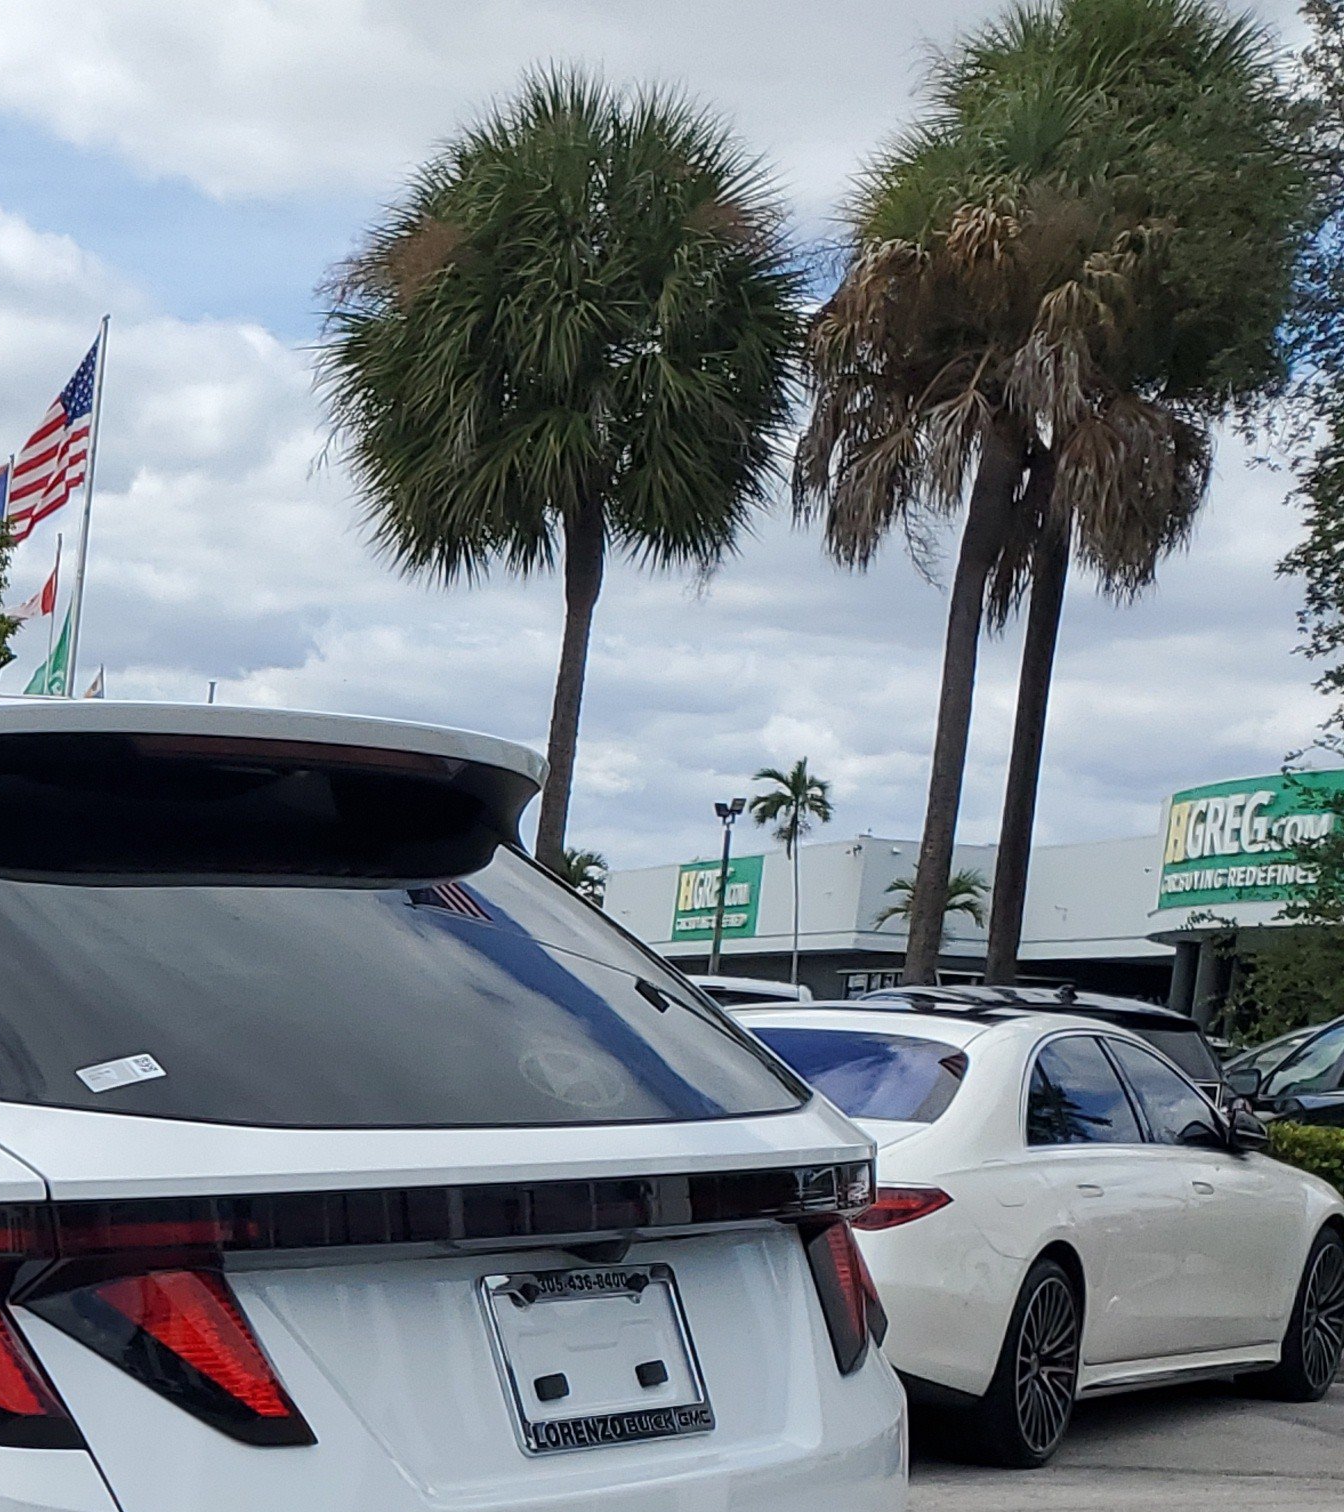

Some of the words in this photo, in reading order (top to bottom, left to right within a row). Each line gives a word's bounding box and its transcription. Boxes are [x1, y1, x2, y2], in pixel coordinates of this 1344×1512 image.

[532, 1416, 621, 1448] LORENZO
[625, 1412, 674, 1434] BUICK
[677, 1410, 712, 1428] GMC
